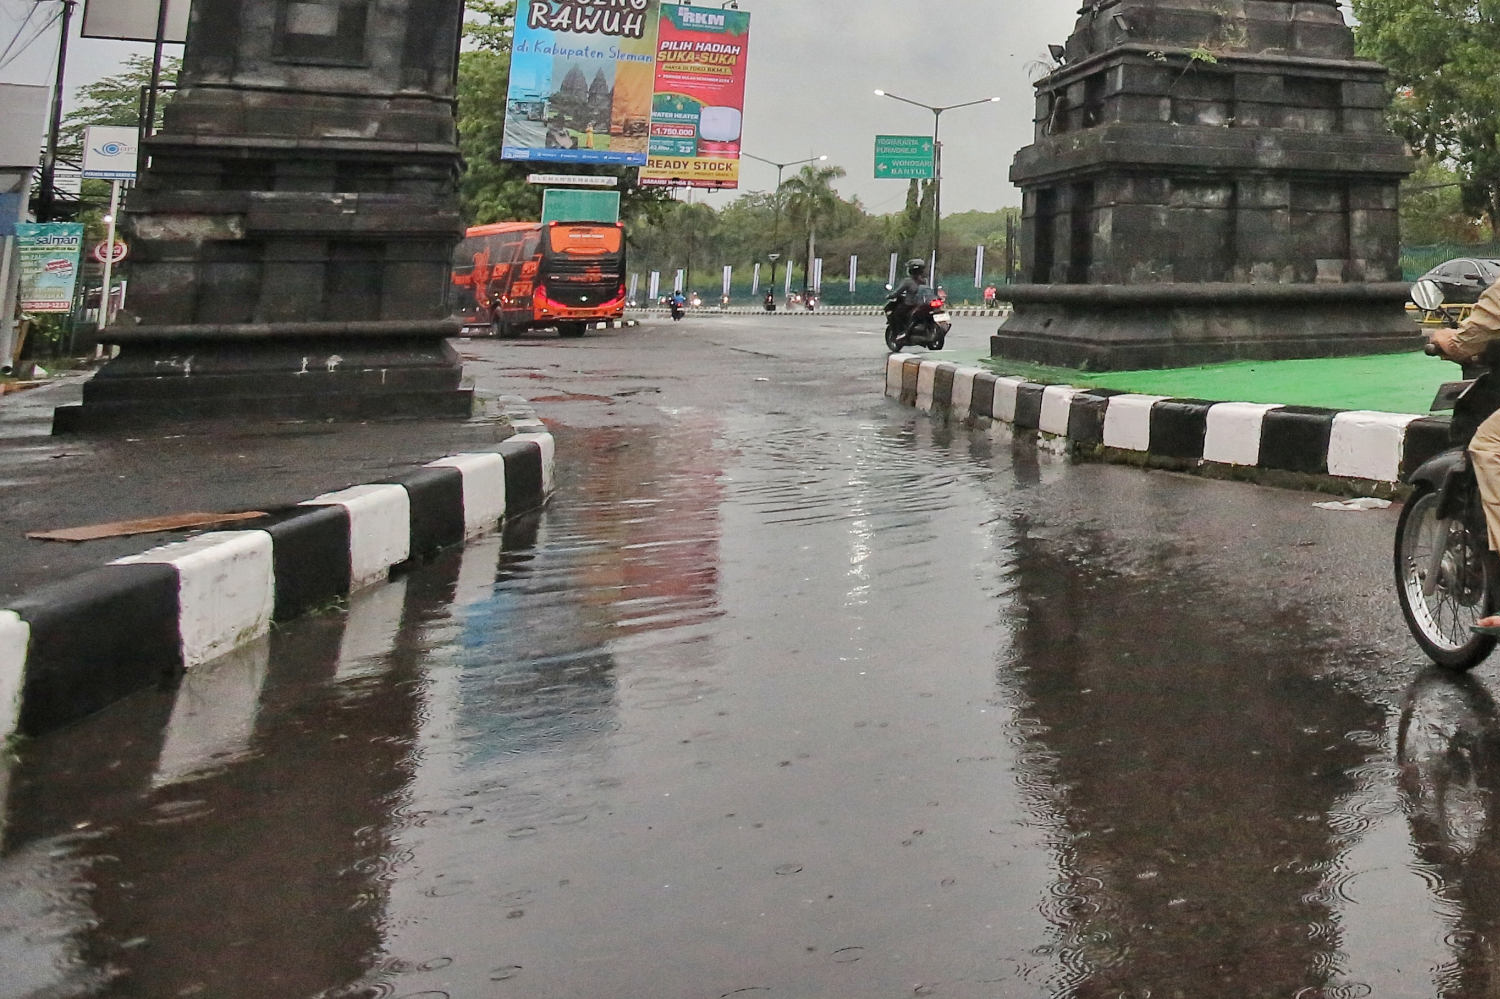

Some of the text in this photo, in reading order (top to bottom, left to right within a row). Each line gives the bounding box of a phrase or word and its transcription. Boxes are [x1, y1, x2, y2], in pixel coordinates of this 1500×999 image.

[529, 1, 644, 37] RAWUH
[682, 11, 725, 27] RKM
[516, 39, 653, 63] di Kabupaten Sleman
[660, 40, 741, 56] PILIH HADIAH
[656, 50, 738, 66] SUKA-SUKA
[648, 159, 734, 172] READY STOCK
[35, 233, 78, 246] salman
